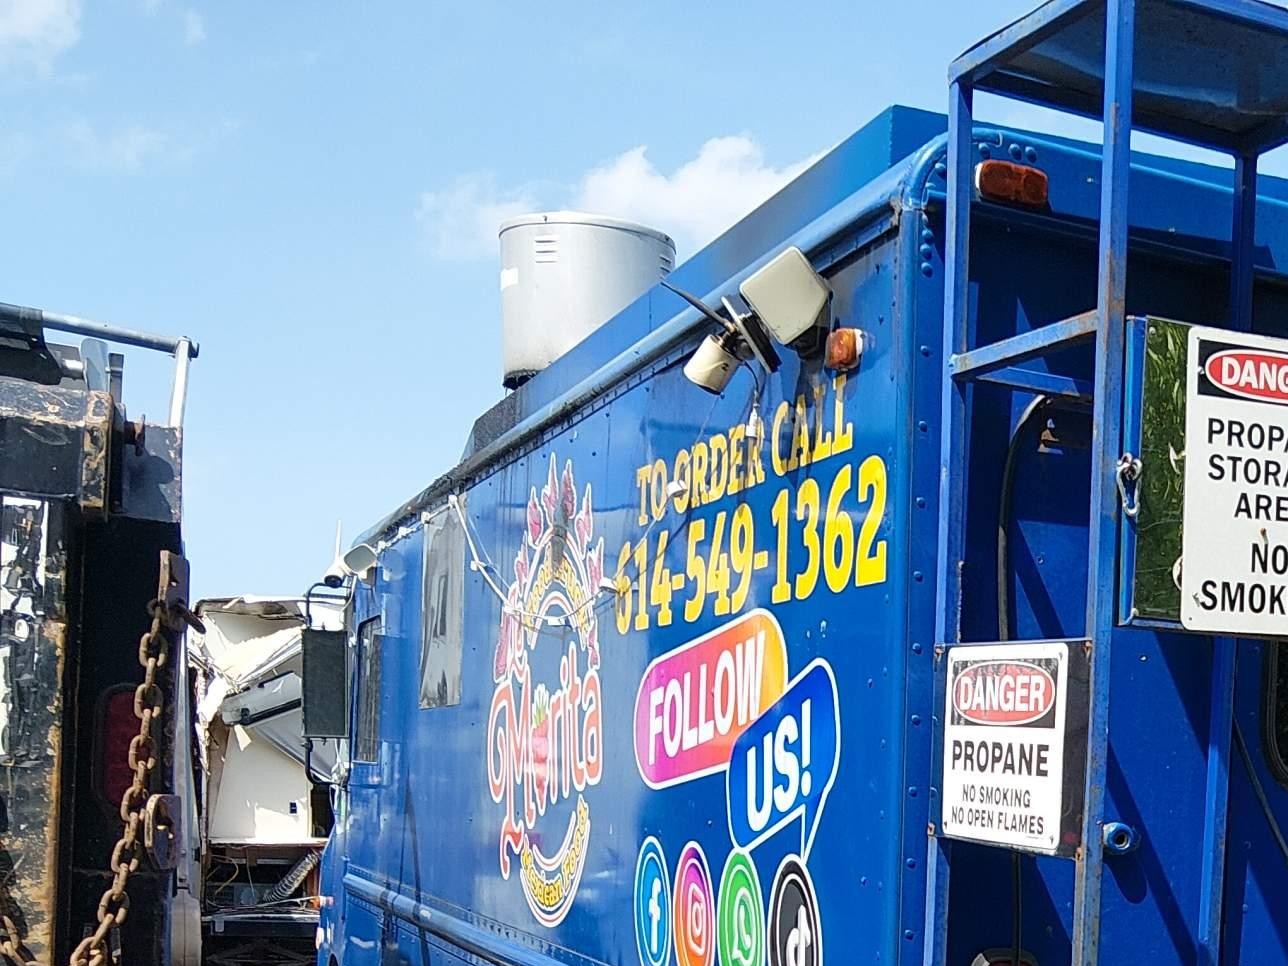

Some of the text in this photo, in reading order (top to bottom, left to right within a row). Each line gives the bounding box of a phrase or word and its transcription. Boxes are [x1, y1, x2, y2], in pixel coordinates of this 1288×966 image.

[636, 374, 853, 526] TO ORDER CALL
[615, 455, 887, 635] 614-549-1362
[1251, 543, 1288, 575] NO
[649, 630, 765, 766] FOLLOW
[959, 675, 1046, 713] DANGER
[747, 699, 811, 832] US!
[952, 739, 1049, 777] PROPANE
[962, 784, 1031, 808] NO SMOKING
[952, 806, 1044, 835] NO OPEN FLAMES
